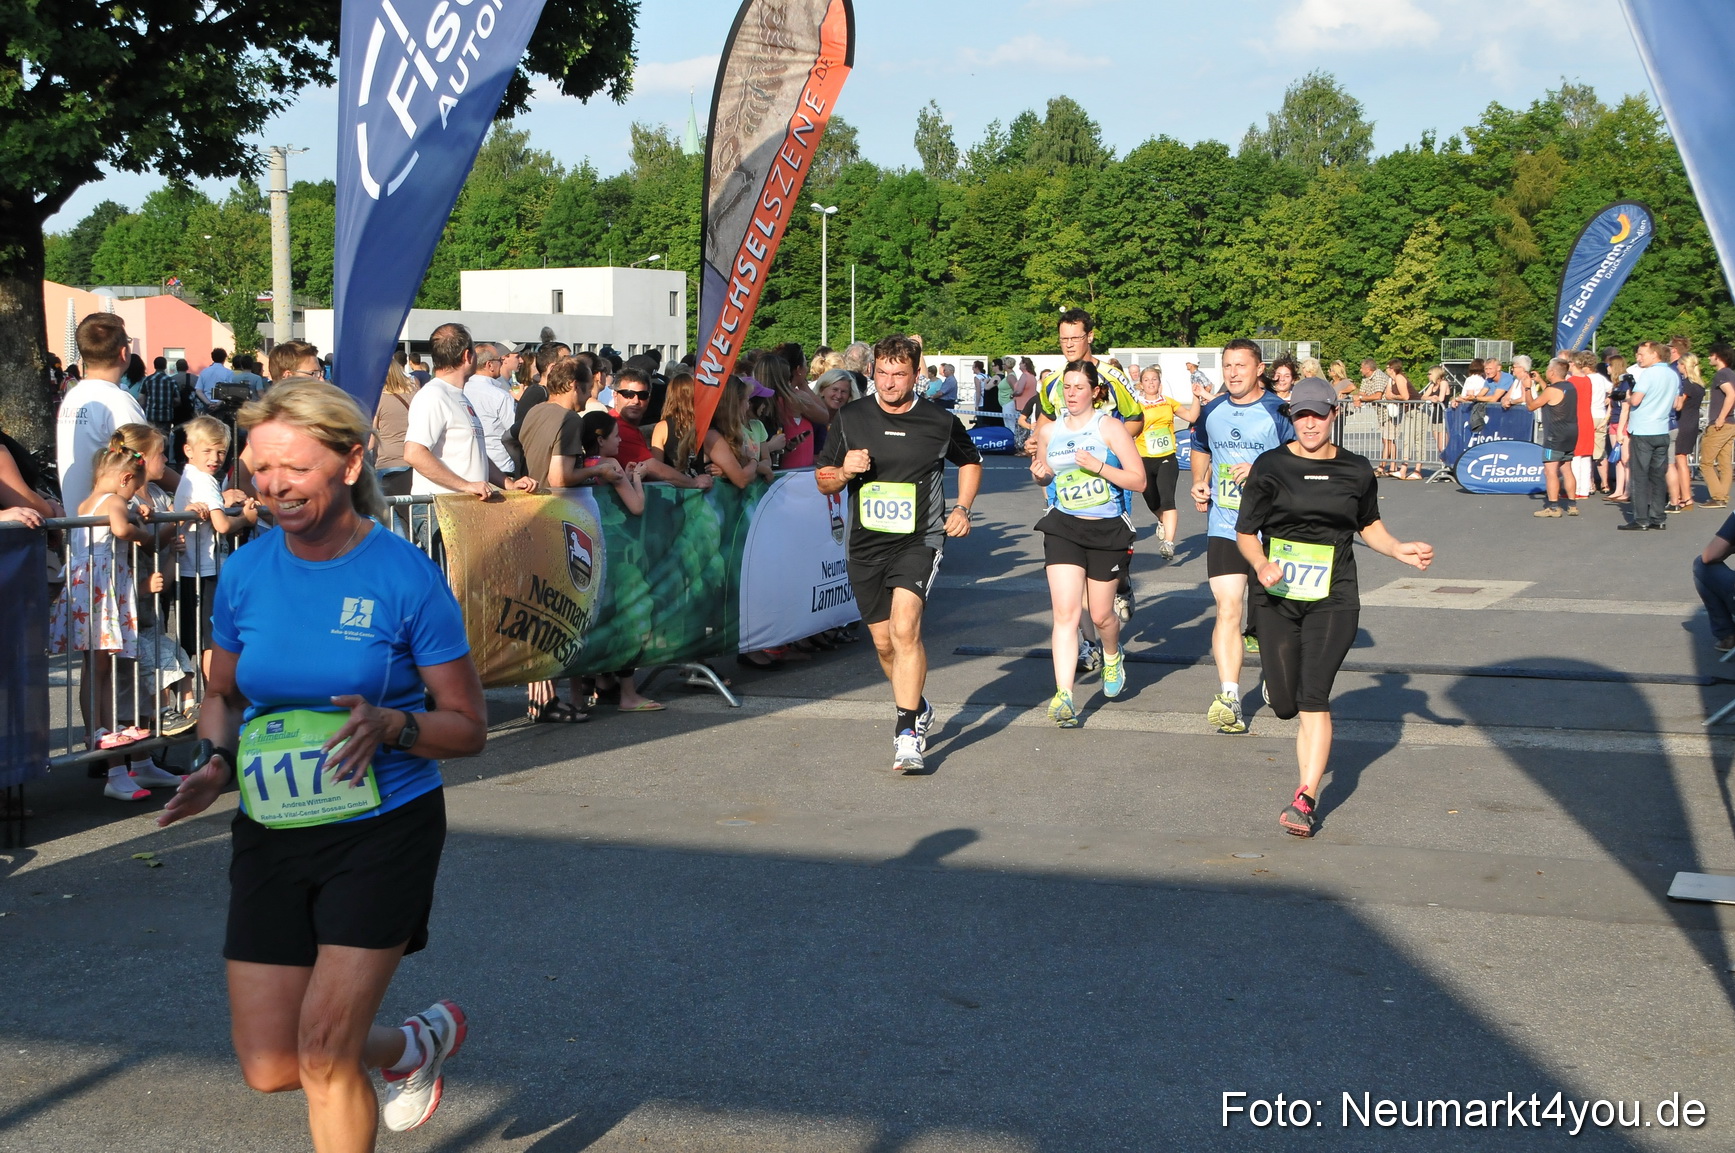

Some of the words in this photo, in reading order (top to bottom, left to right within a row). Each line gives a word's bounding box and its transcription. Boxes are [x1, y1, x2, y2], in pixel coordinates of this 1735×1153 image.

[387, 0, 477, 139] Fis
[1561, 243, 1625, 328] Frischmann
[1150, 436, 1170, 449] 766
[1481, 463, 1544, 477] Fischer
[1060, 478, 1105, 502] 1210
[862, 498, 913, 520] 1093
[821, 559, 848, 580] Neuma
[1275, 558, 1329, 588] 077
[306, 795, 342, 806] Wittmann
[321, 805, 346, 814] Sossau
[347, 800, 368, 809] GmbH
